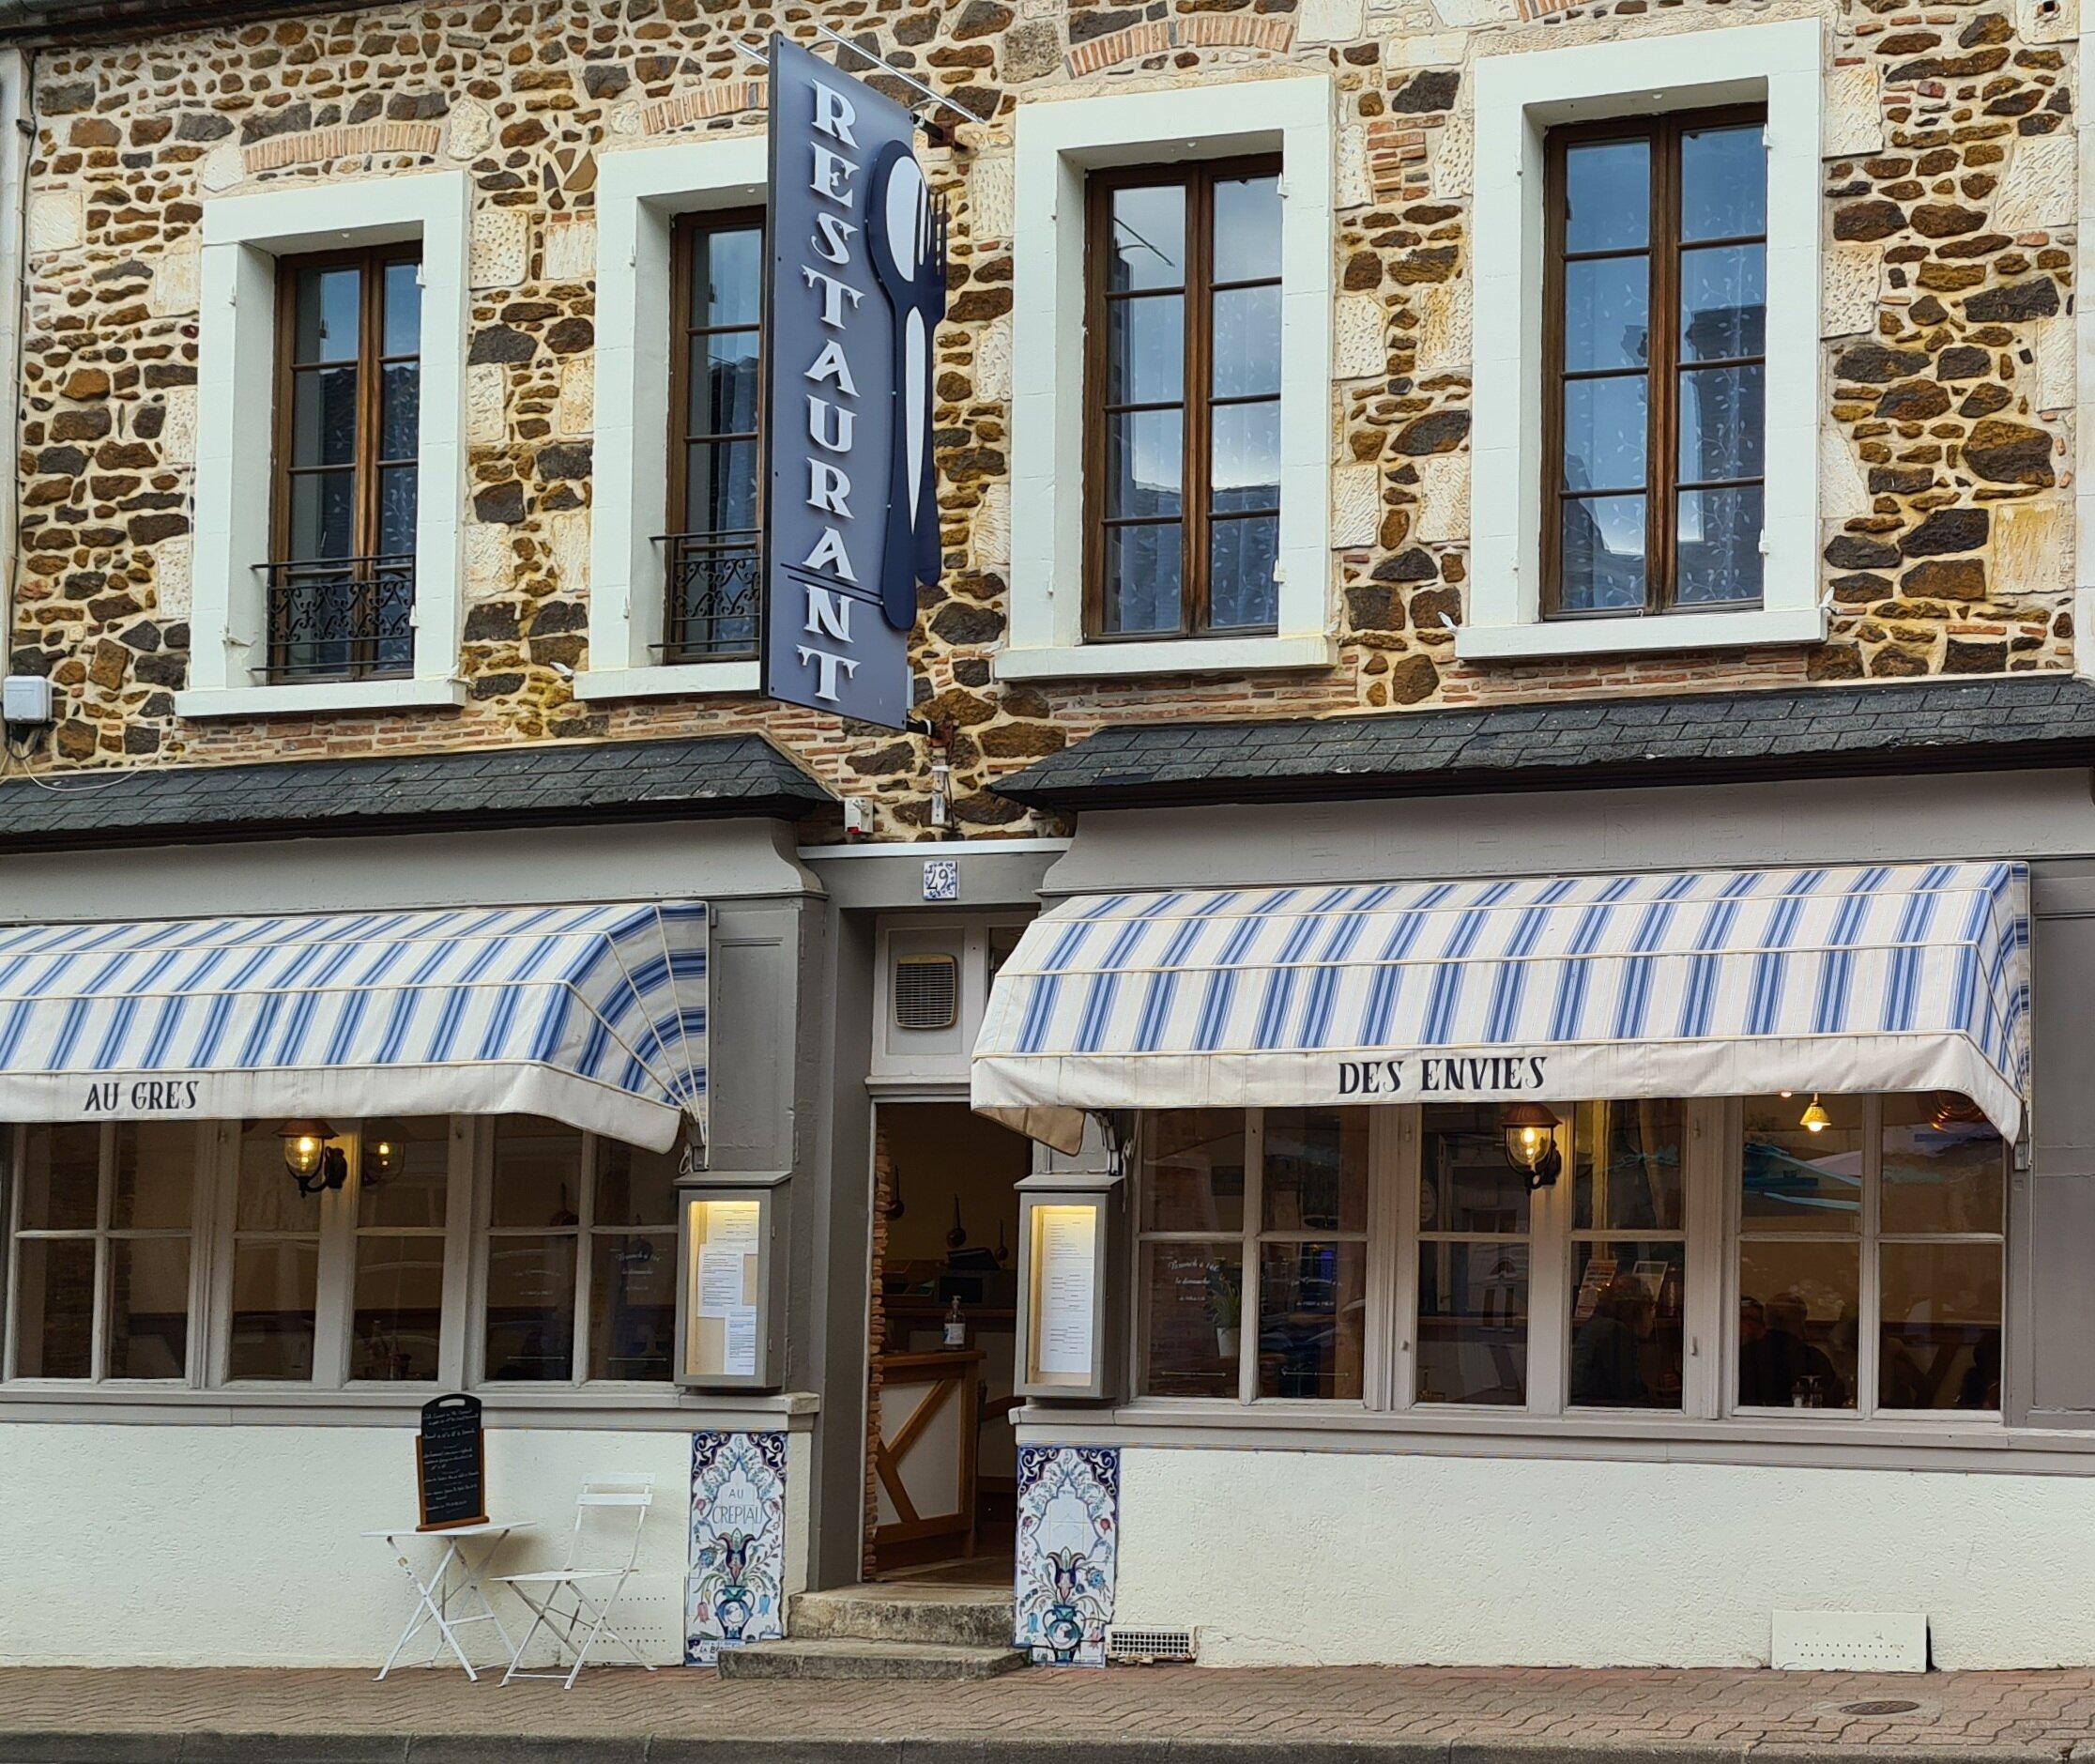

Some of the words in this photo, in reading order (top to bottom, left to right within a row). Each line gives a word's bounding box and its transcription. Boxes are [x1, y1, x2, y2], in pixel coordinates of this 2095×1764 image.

[796, 77, 865, 702] RESTAURANT
[1338, 1060, 1404, 1095] DES
[1420, 1056, 1548, 1091] ENVIES
[83, 1082, 120, 1111] AU
[130, 1081, 200, 1110] GRES
[728, 1488, 744, 1499] AU
[711, 1505, 763, 1525] CREPIAU
